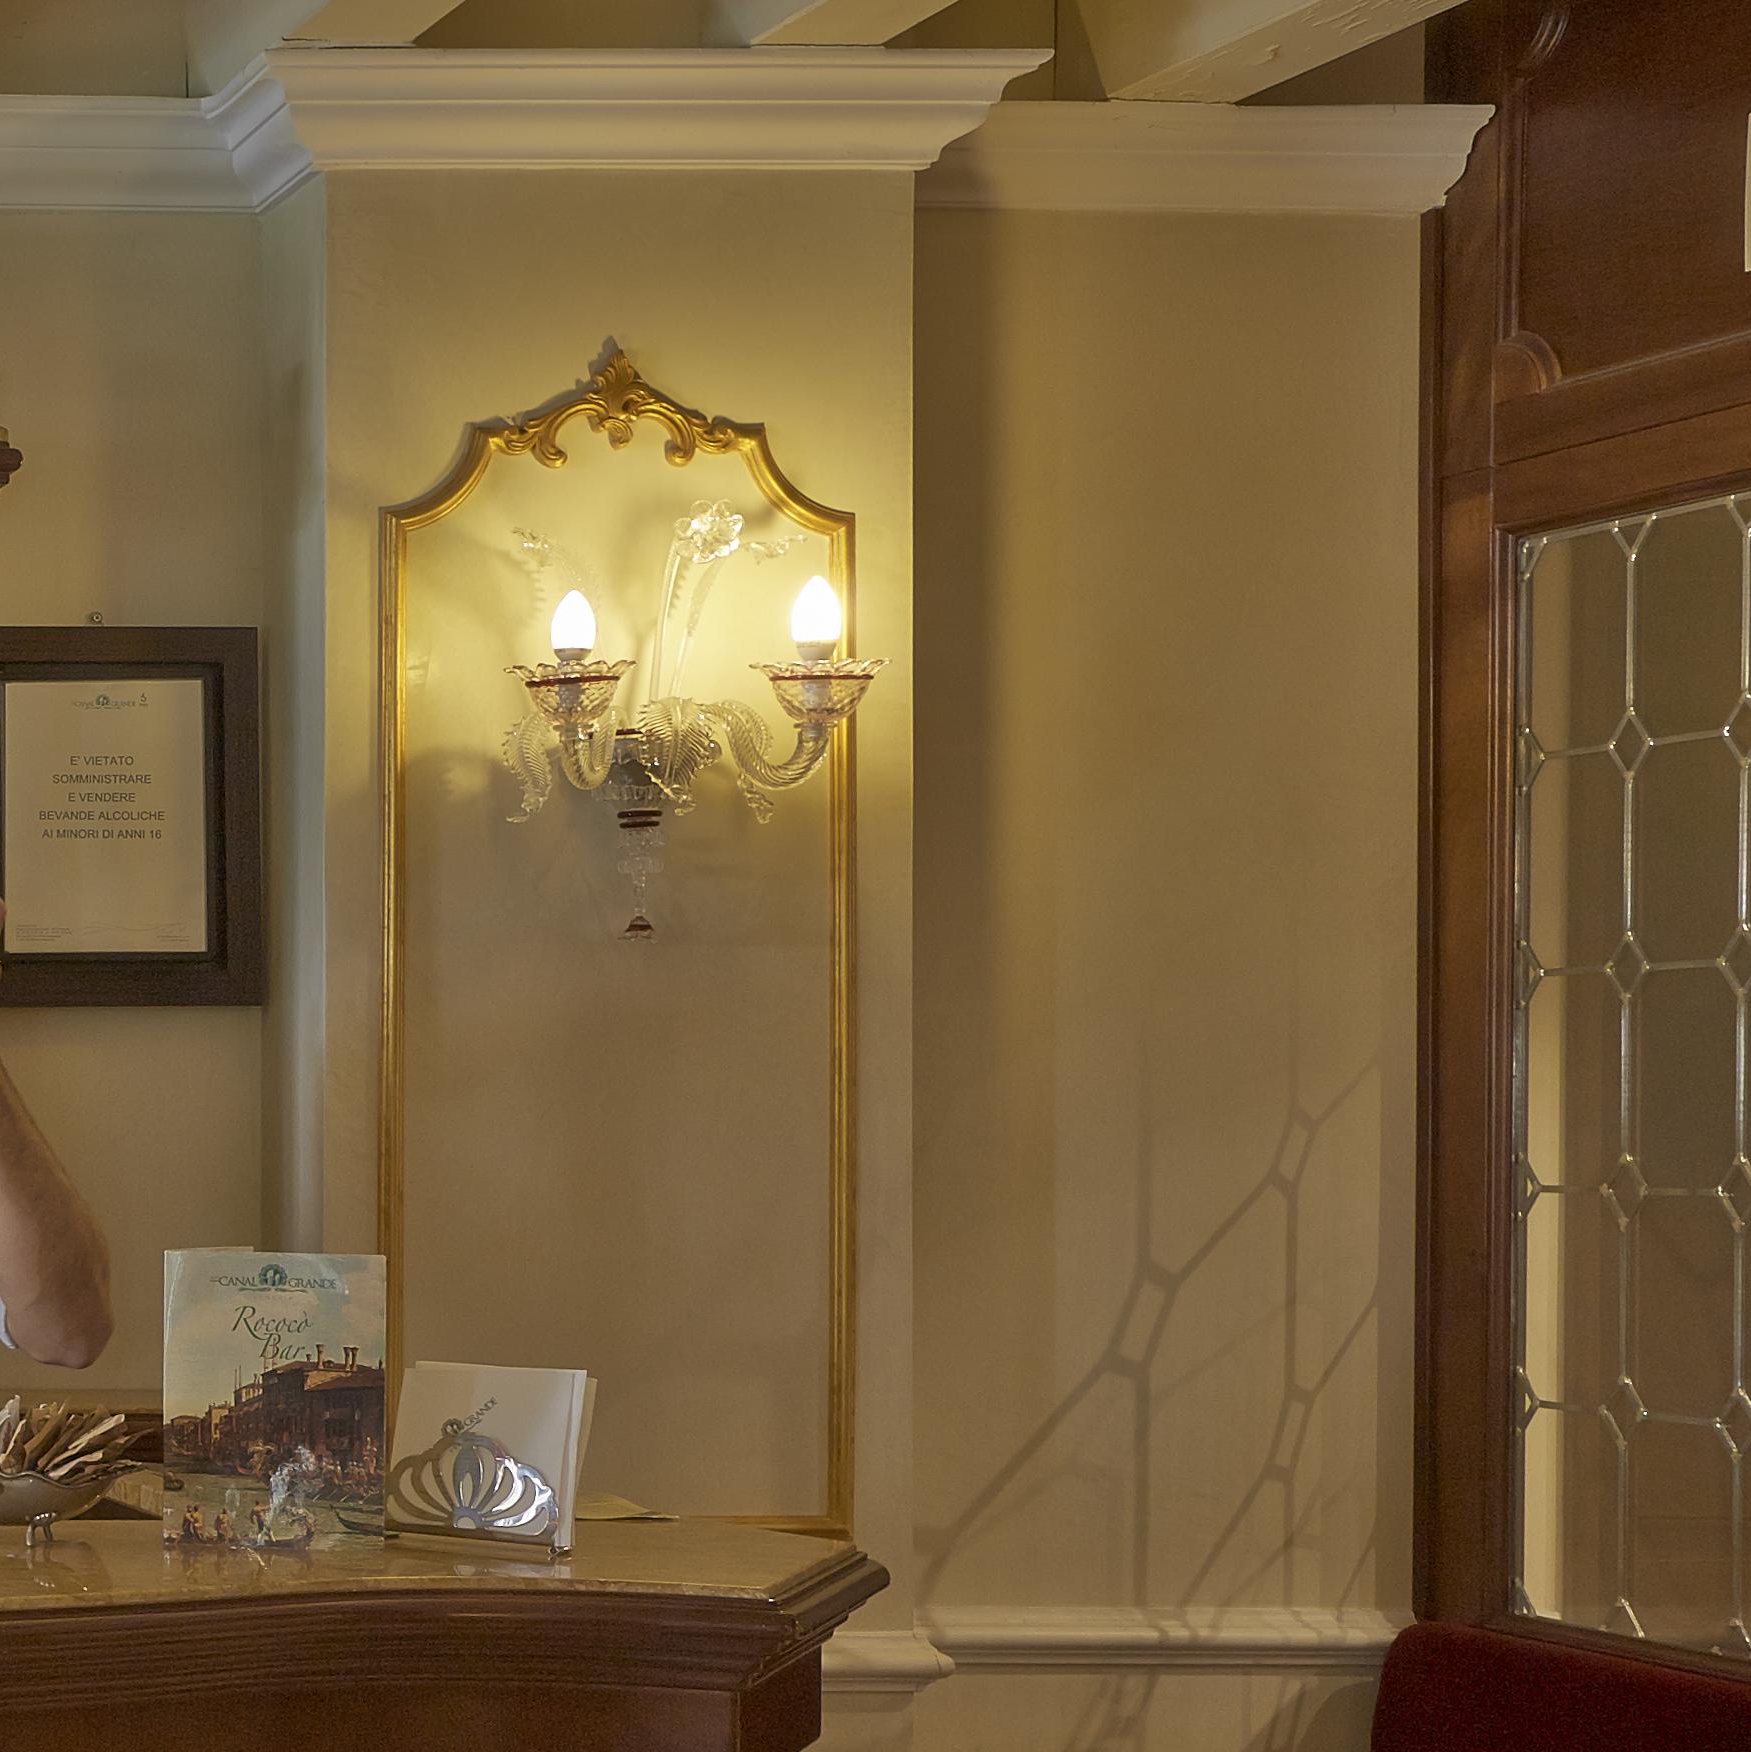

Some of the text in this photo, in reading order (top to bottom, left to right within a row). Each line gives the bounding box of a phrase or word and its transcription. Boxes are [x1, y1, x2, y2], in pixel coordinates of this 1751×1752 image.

[84, 756, 134, 765] VIETATO
[52, 774, 152, 784] SOMMINISTRARE
[68, 793, 136, 802] E VENDERE
[39, 811, 165, 820] BEVANDE ALCOLICHE
[42, 829, 161, 838] AI MINORI DI ANNI 16
[218, 1276, 337, 1289] CANAL GRANDE
[232, 1305, 313, 1340] Rococò
[259, 1332, 305, 1359] Bar
[463, 1396, 497, 1426] GRANDE
